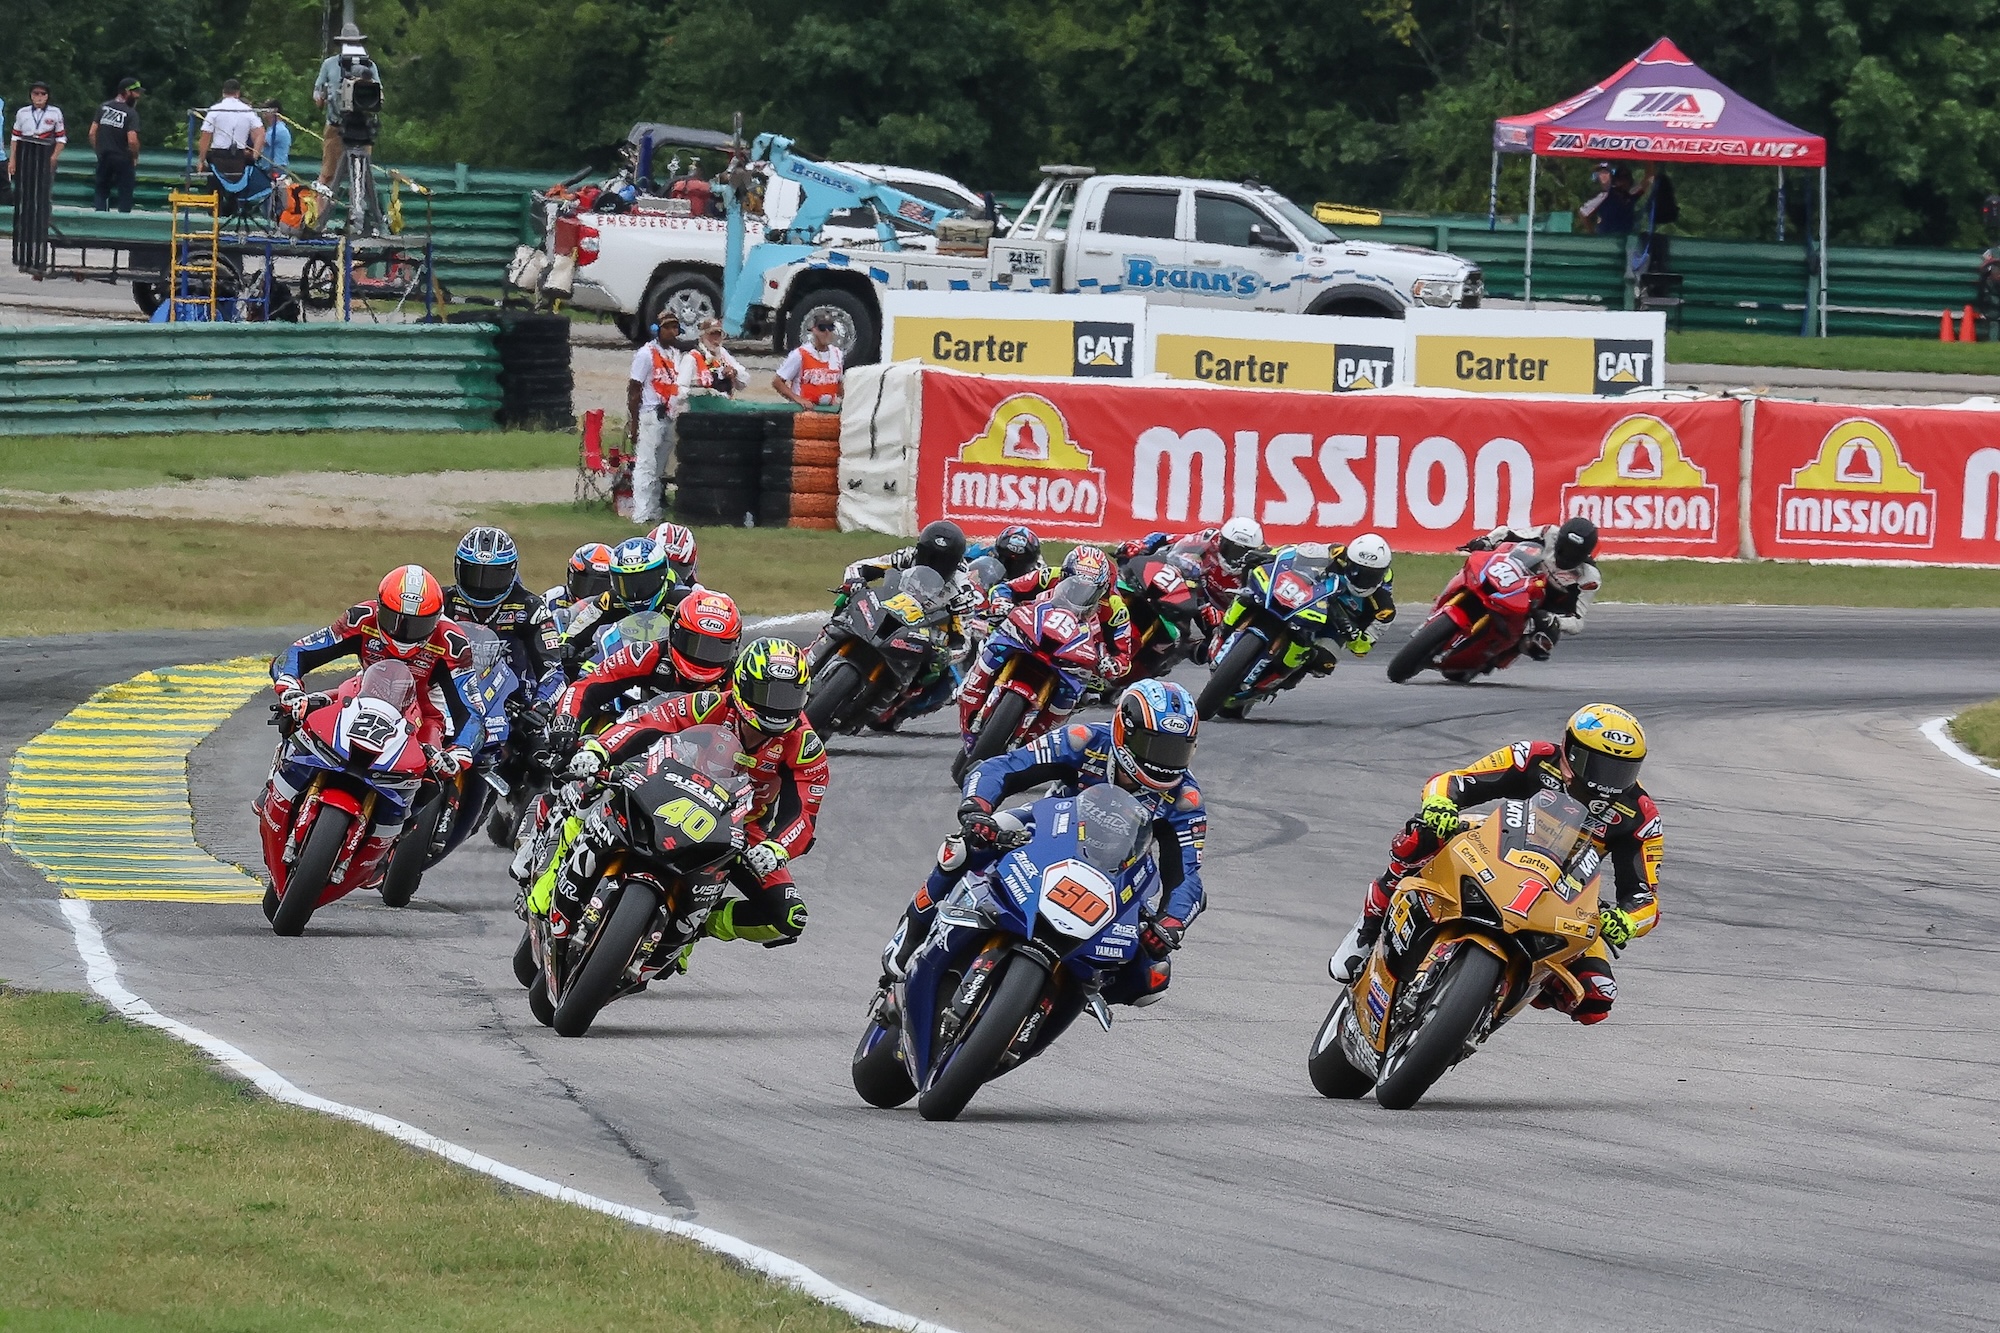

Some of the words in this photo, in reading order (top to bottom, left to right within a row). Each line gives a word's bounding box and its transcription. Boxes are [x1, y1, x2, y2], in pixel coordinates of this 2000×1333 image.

[1588, 135, 1748, 156] MOTOAMERICA
[597, 215, 688, 228] EMERGENCY
[1127, 258, 1258, 296] Brann's
[932, 331, 1028, 364] Carter
[1077, 334, 1130, 365] CAT
[1195, 349, 1289, 384] Carter
[1336, 357, 1390, 389] CAT
[1455, 349, 1549, 382] Carter
[1599, 351, 1651, 383] CAT
[951, 471, 1099, 515] MISSION
[1131, 425, 1536, 531] MISSION
[1567, 494, 1711, 531] MISSION
[1784, 497, 1928, 536] MISSION
[696, 603, 732, 619] MISSION
[702, 618, 723, 631] Arai
[1044, 611, 1077, 639] 95
[770, 664, 795, 676] Arai
[346, 711, 398, 748] 27
[1165, 718, 1187, 732] Arai
[1603, 730, 1634, 744] KYT
[663, 771, 726, 812] SUZUKI
[653, 795, 718, 843] 40
[1506, 800, 1524, 828] KATO
[780, 819, 806, 848] SUZUKI
[1461, 847, 1478, 864] Carter
[1519, 855, 1550, 872] Carter
[1578, 848, 1600, 878] KATO
[1003, 874, 1028, 905] YAMAHA
[1045, 875, 1110, 927] 50
[1501, 877, 1548, 919] 1
[1095, 945, 1123, 959] YAMAHA
